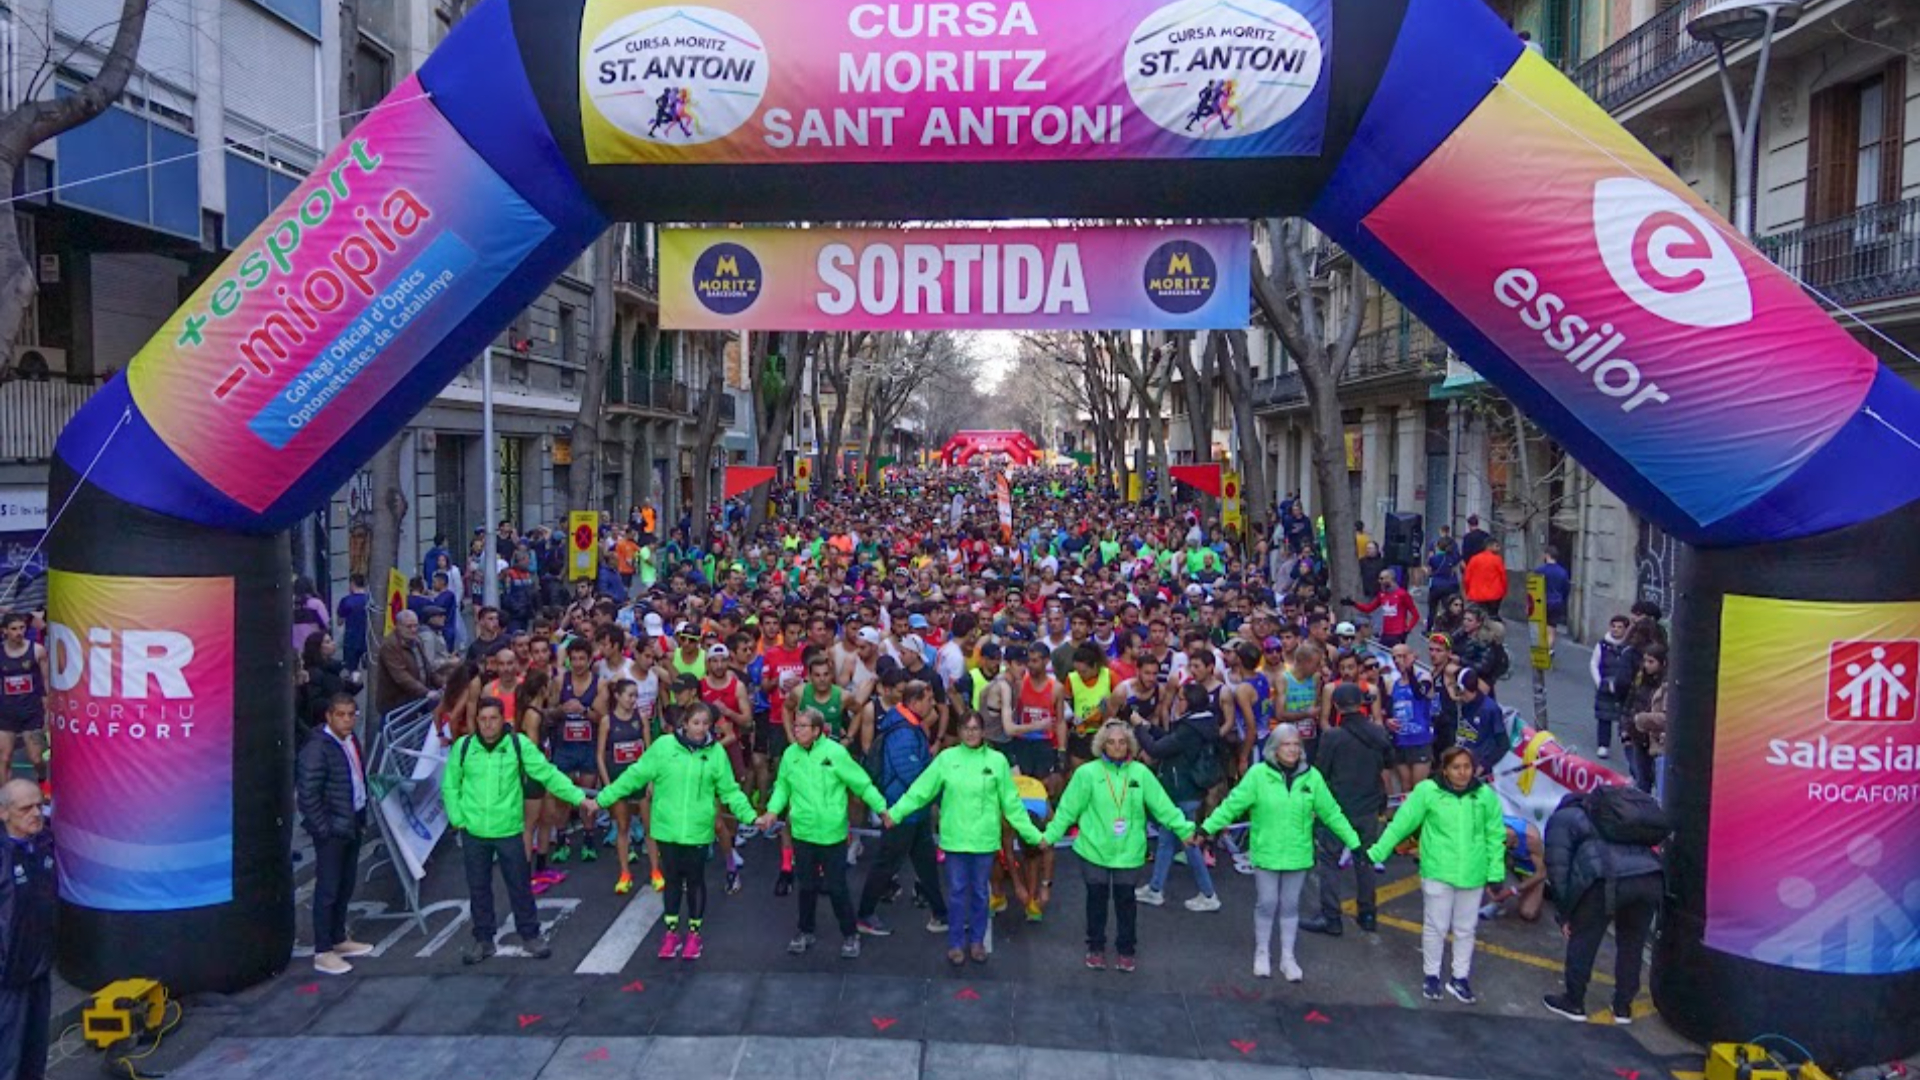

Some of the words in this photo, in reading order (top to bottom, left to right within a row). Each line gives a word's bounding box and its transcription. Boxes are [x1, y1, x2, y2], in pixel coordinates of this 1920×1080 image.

[847, 1, 1038, 39] CURSA
[1168, 26, 1215, 44] CURSA
[1220, 26, 1276, 42] MORITZ
[625, 36, 671, 53] CURSA
[675, 36, 726, 52] MORITZ
[1138, 50, 1181, 77] ST.
[1187, 46, 1306, 74] ANTONI
[598, 57, 637, 84] ST.
[643, 55, 755, 83] ANTONI
[838, 50, 1047, 94] MORITZ
[762, 106, 905, 148] SANT
[919, 104, 1123, 147] ANTONI
[698, 280, 756, 291] MORITZ
[816, 242, 1091, 316] SORTIDA
[1149, 277, 1210, 290] MORITZ
[288, 345, 376, 429] Optometristes
[374, 328, 394, 346] de
[389, 269, 454, 328] Catalunya
[331, 317, 374, 359] Oficial
[1493, 267, 1671, 413] essilor
[48, 621, 195, 700] DiR
[1808, 782, 1919, 803] ROCAFORT
